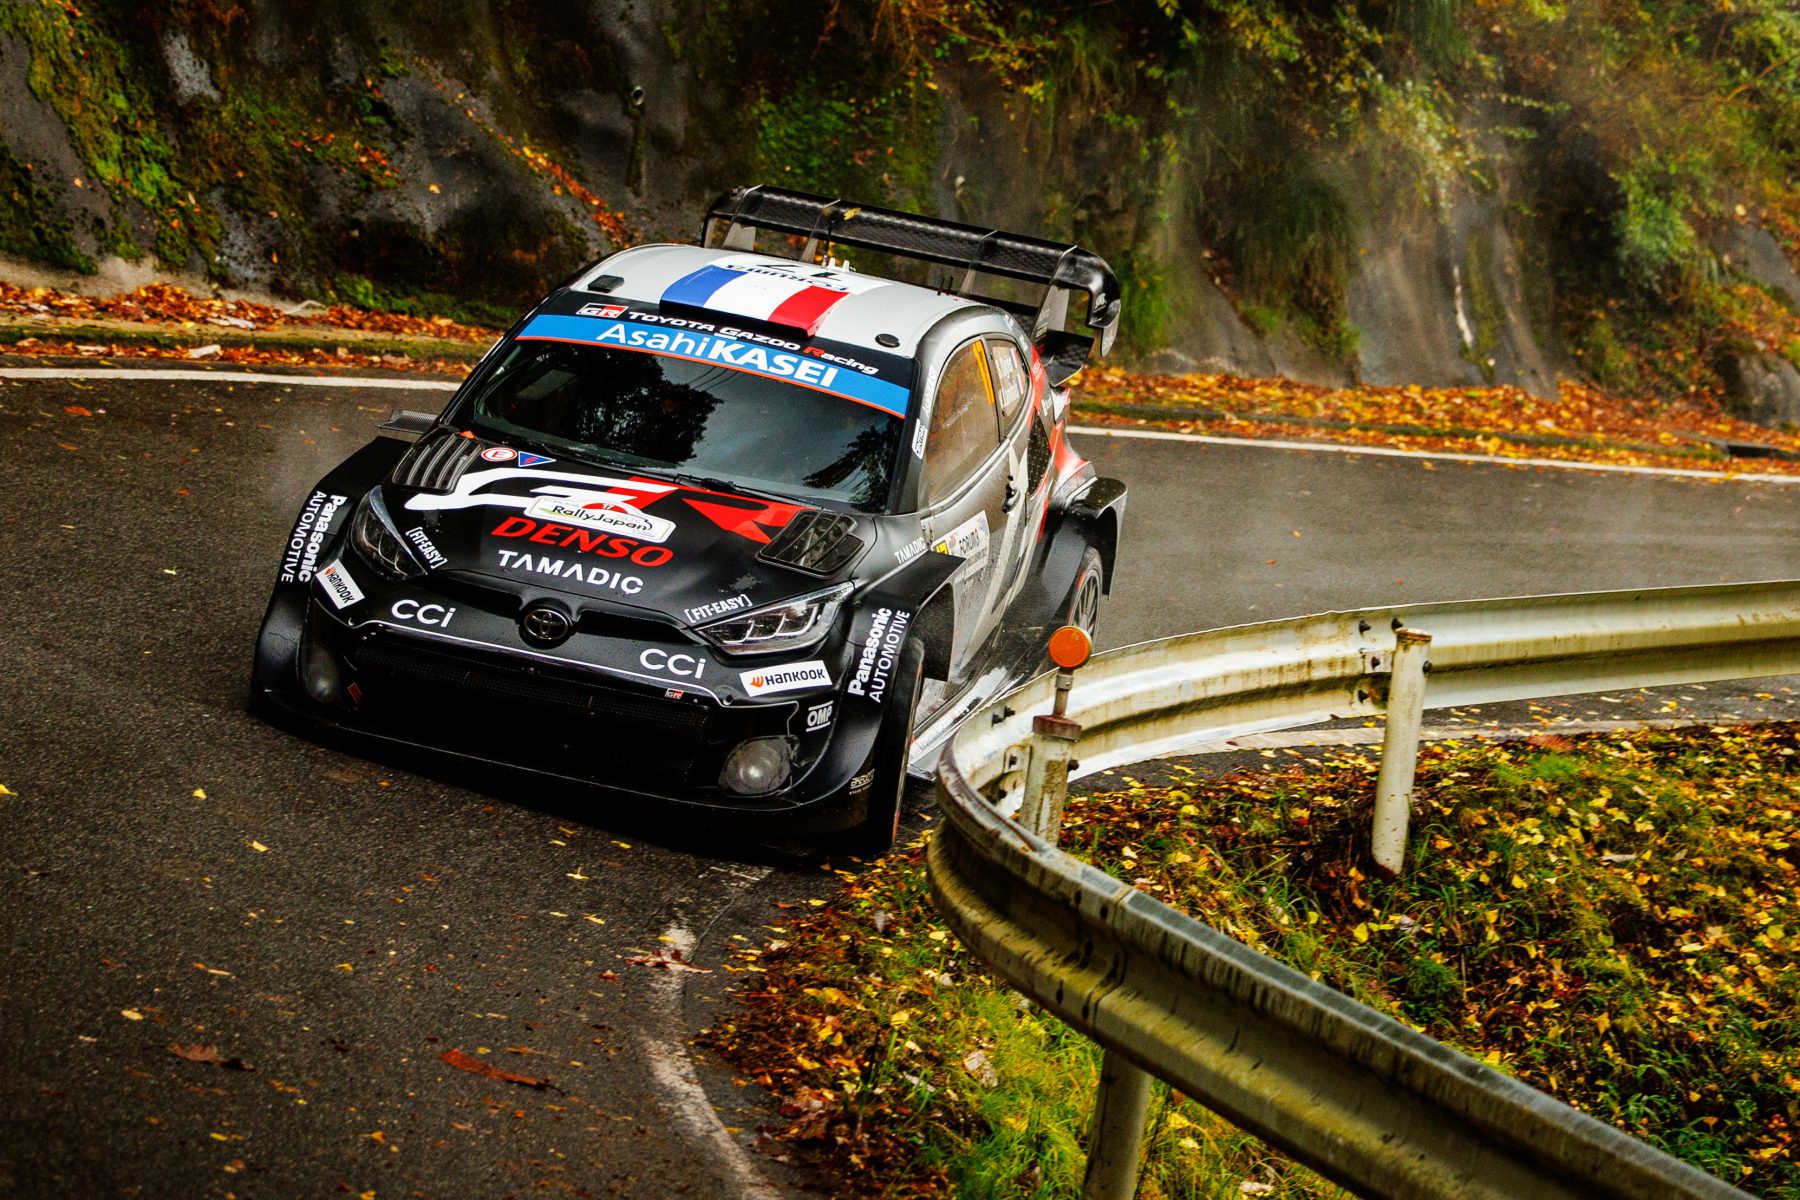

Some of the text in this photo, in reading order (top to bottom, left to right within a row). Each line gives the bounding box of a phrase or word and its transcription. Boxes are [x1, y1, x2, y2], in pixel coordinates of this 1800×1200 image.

[577, 303, 879, 375] GR TOYOTA GAZOO Racing
[596, 323, 838, 387] AsahiKASEI
[281, 490, 327, 583] AUTOMOTIVE
[298, 494, 348, 583] Panasonic
[491, 516, 673, 567] DENSO
[552, 505, 647, 531] RallyJapan
[498, 550, 644, 594] TAMADIC
[894, 536, 926, 564] TAMADIC
[391, 599, 456, 628] CCi
[639, 648, 707, 680] CCi
[847, 607, 892, 697] Panasonic
[869, 609, 910, 703] AUTOMOTIVE
[806, 704, 833, 727] OMP
